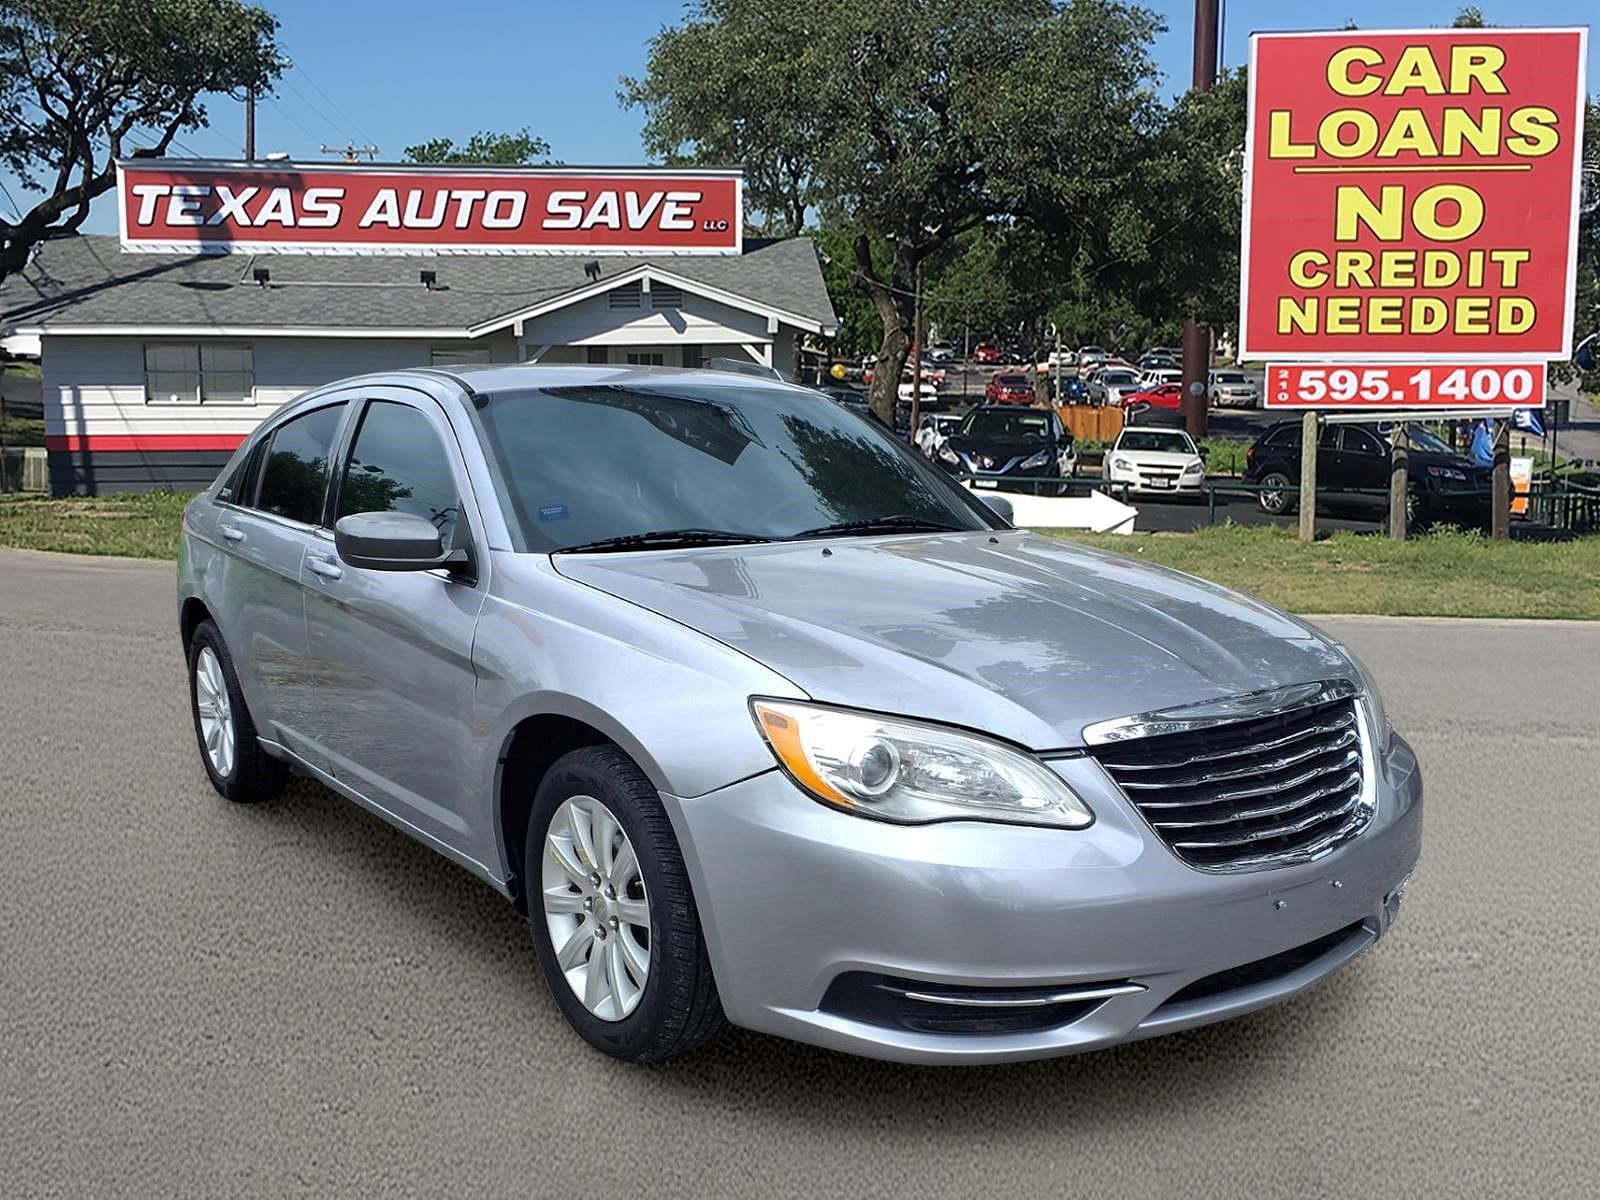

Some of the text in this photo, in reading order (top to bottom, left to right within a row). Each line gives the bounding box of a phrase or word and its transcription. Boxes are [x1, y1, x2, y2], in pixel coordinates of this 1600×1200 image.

[1326, 44, 1508, 97] CAR
[1268, 106, 1560, 159] LOANS
[130, 184, 728, 230] TEXAS AUTO SAVE LLC
[1334, 183, 1485, 242] NO
[1288, 249, 1531, 289] CREDIT
[1277, 296, 1536, 336] NEEDED
[1297, 368, 1534, 401] 595.1400
